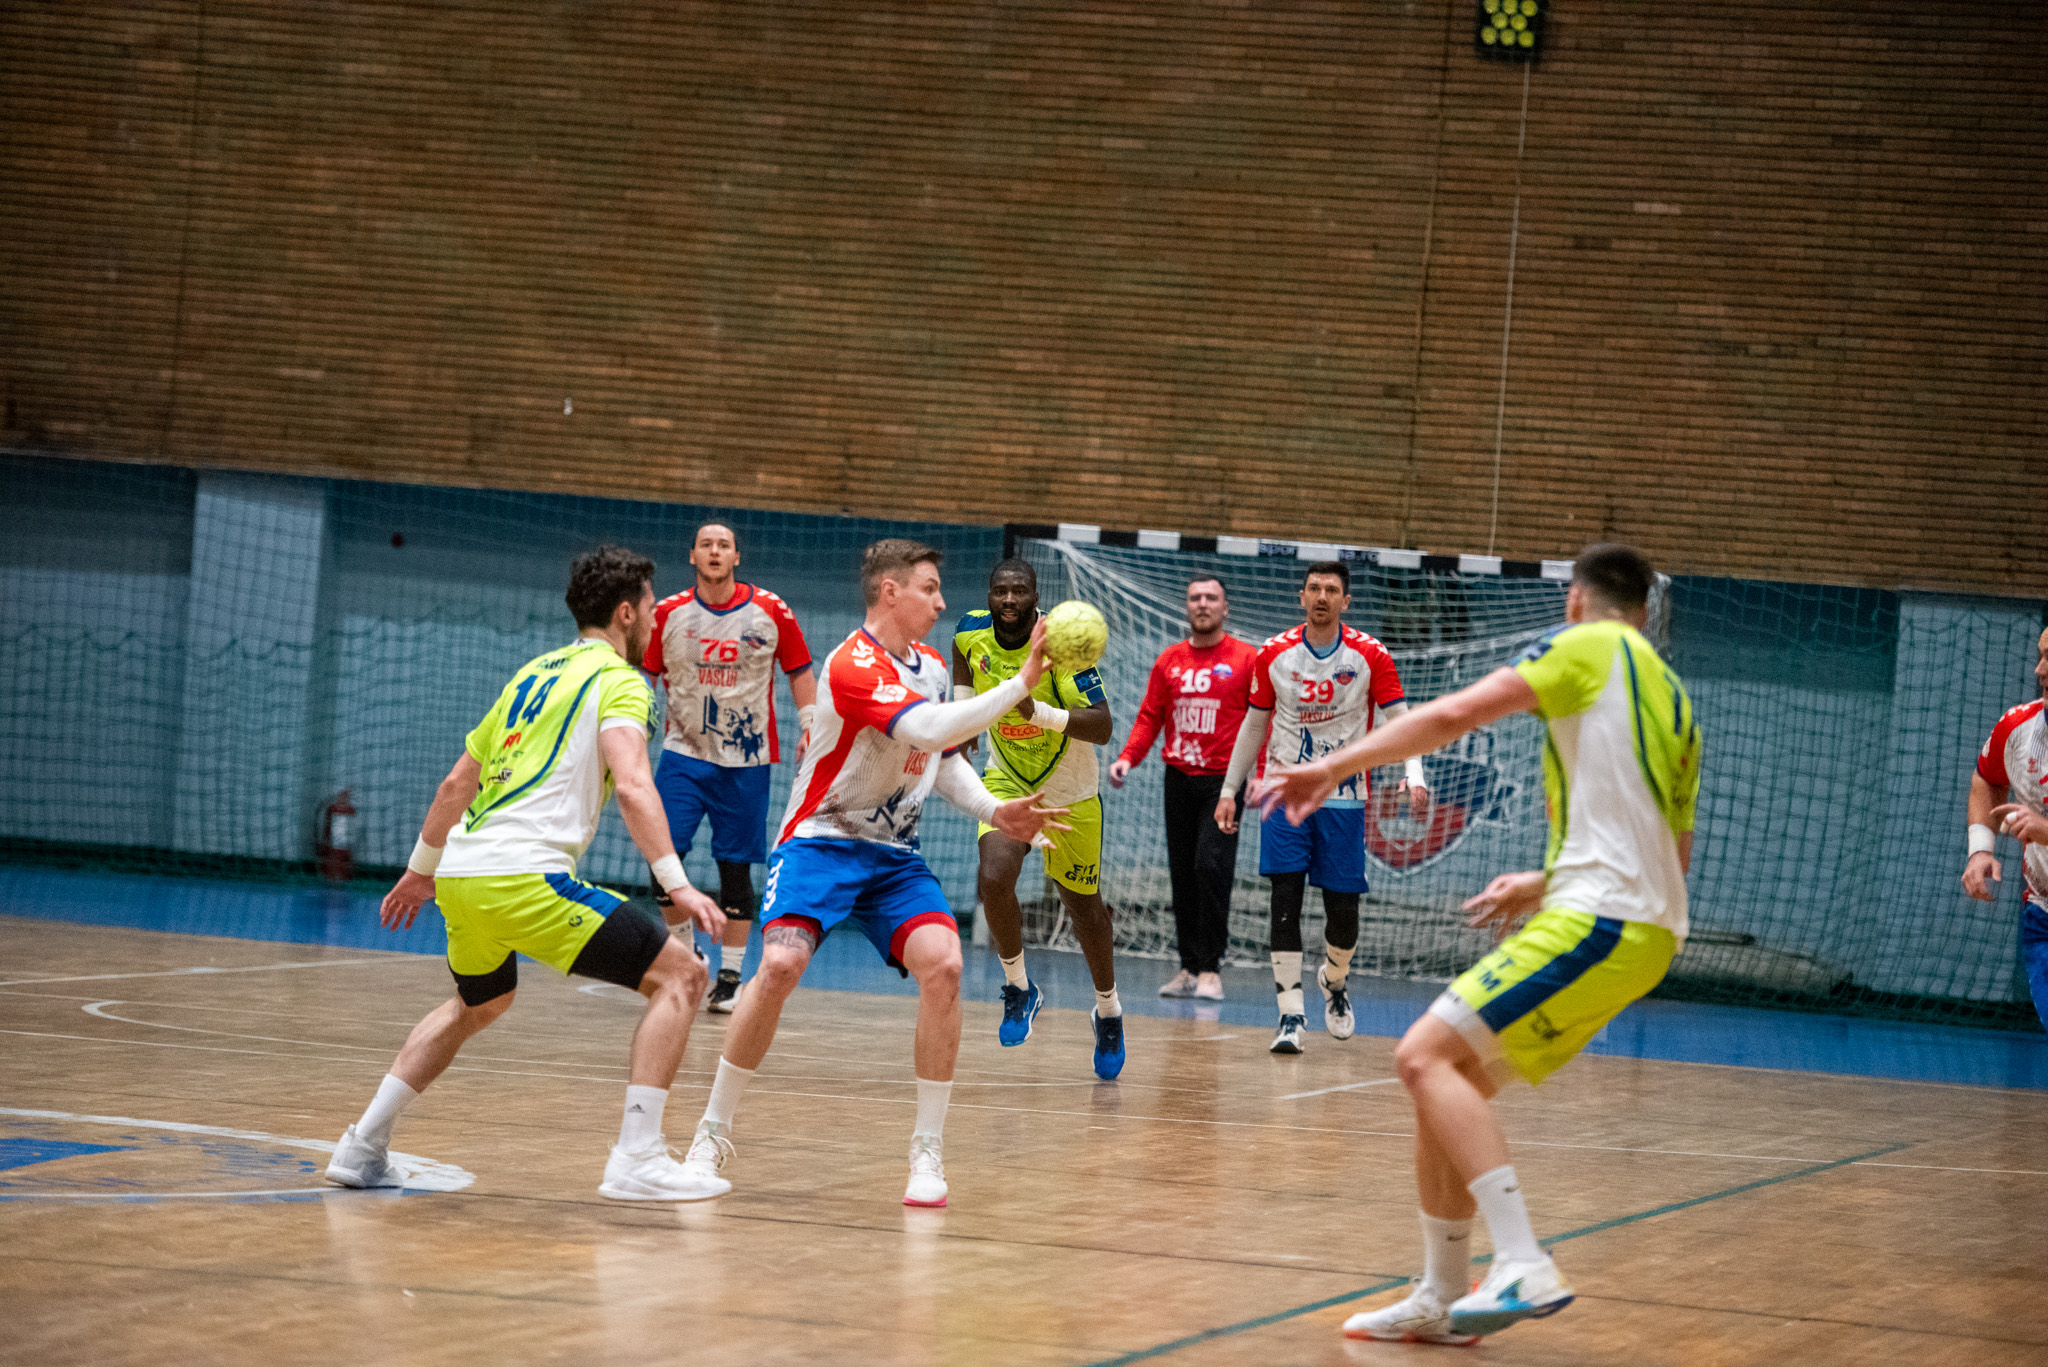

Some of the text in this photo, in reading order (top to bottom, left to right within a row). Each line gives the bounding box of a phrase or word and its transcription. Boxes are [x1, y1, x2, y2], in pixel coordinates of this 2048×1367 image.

[699, 638, 739, 662] 76
[698, 668, 738, 687] VASLUI
[1180, 668, 1212, 693] 16
[505, 674, 560, 730] 14
[1299, 679, 1334, 703] 39
[1002, 726, 1039, 737] CELCO
[1073, 864, 1096, 875] FIT
